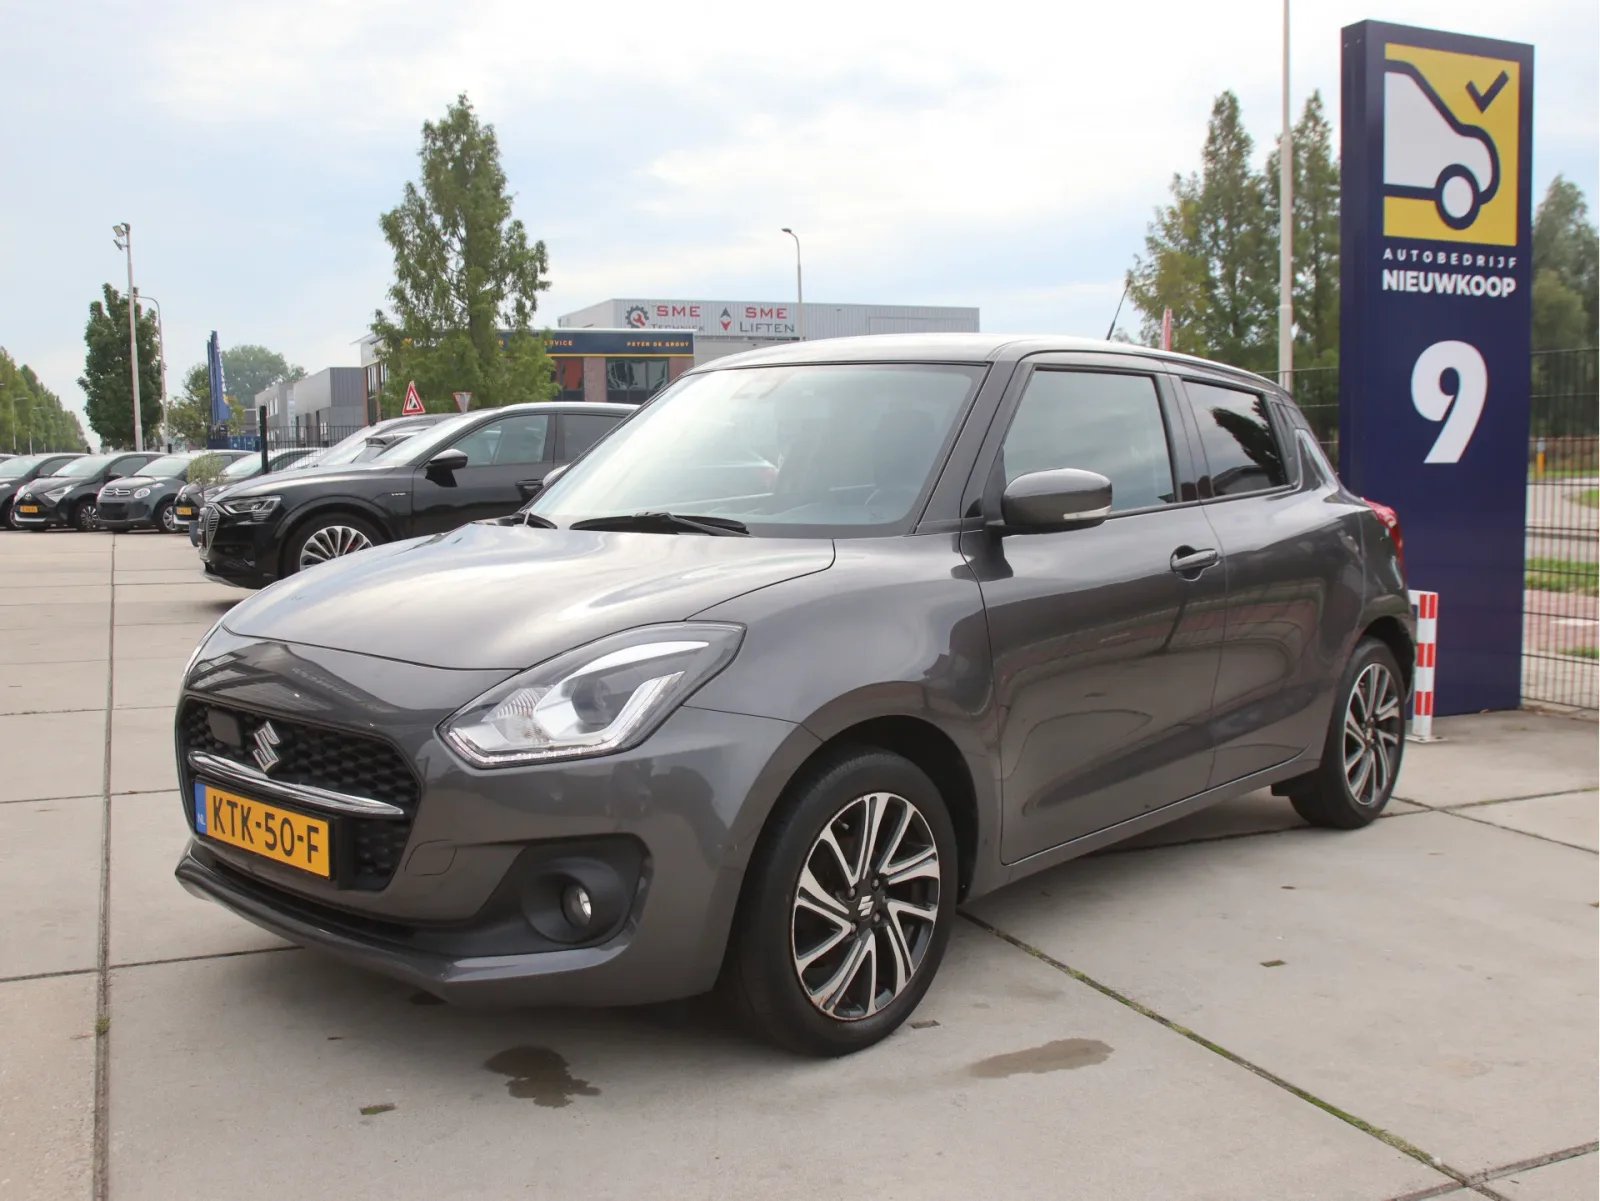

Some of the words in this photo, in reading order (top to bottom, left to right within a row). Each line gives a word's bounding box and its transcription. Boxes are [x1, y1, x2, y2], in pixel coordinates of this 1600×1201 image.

[1383, 248, 1517, 269] AUTOBEDRIJF
[1383, 269, 1517, 298] NIEUWKOOP
[656, 305, 701, 317] SME
[745, 307, 787, 319] SME
[739, 321, 795, 333] LIFTEN
[1411, 340, 1488, 464] 9
[213, 795, 320, 864] KTK-50-F
